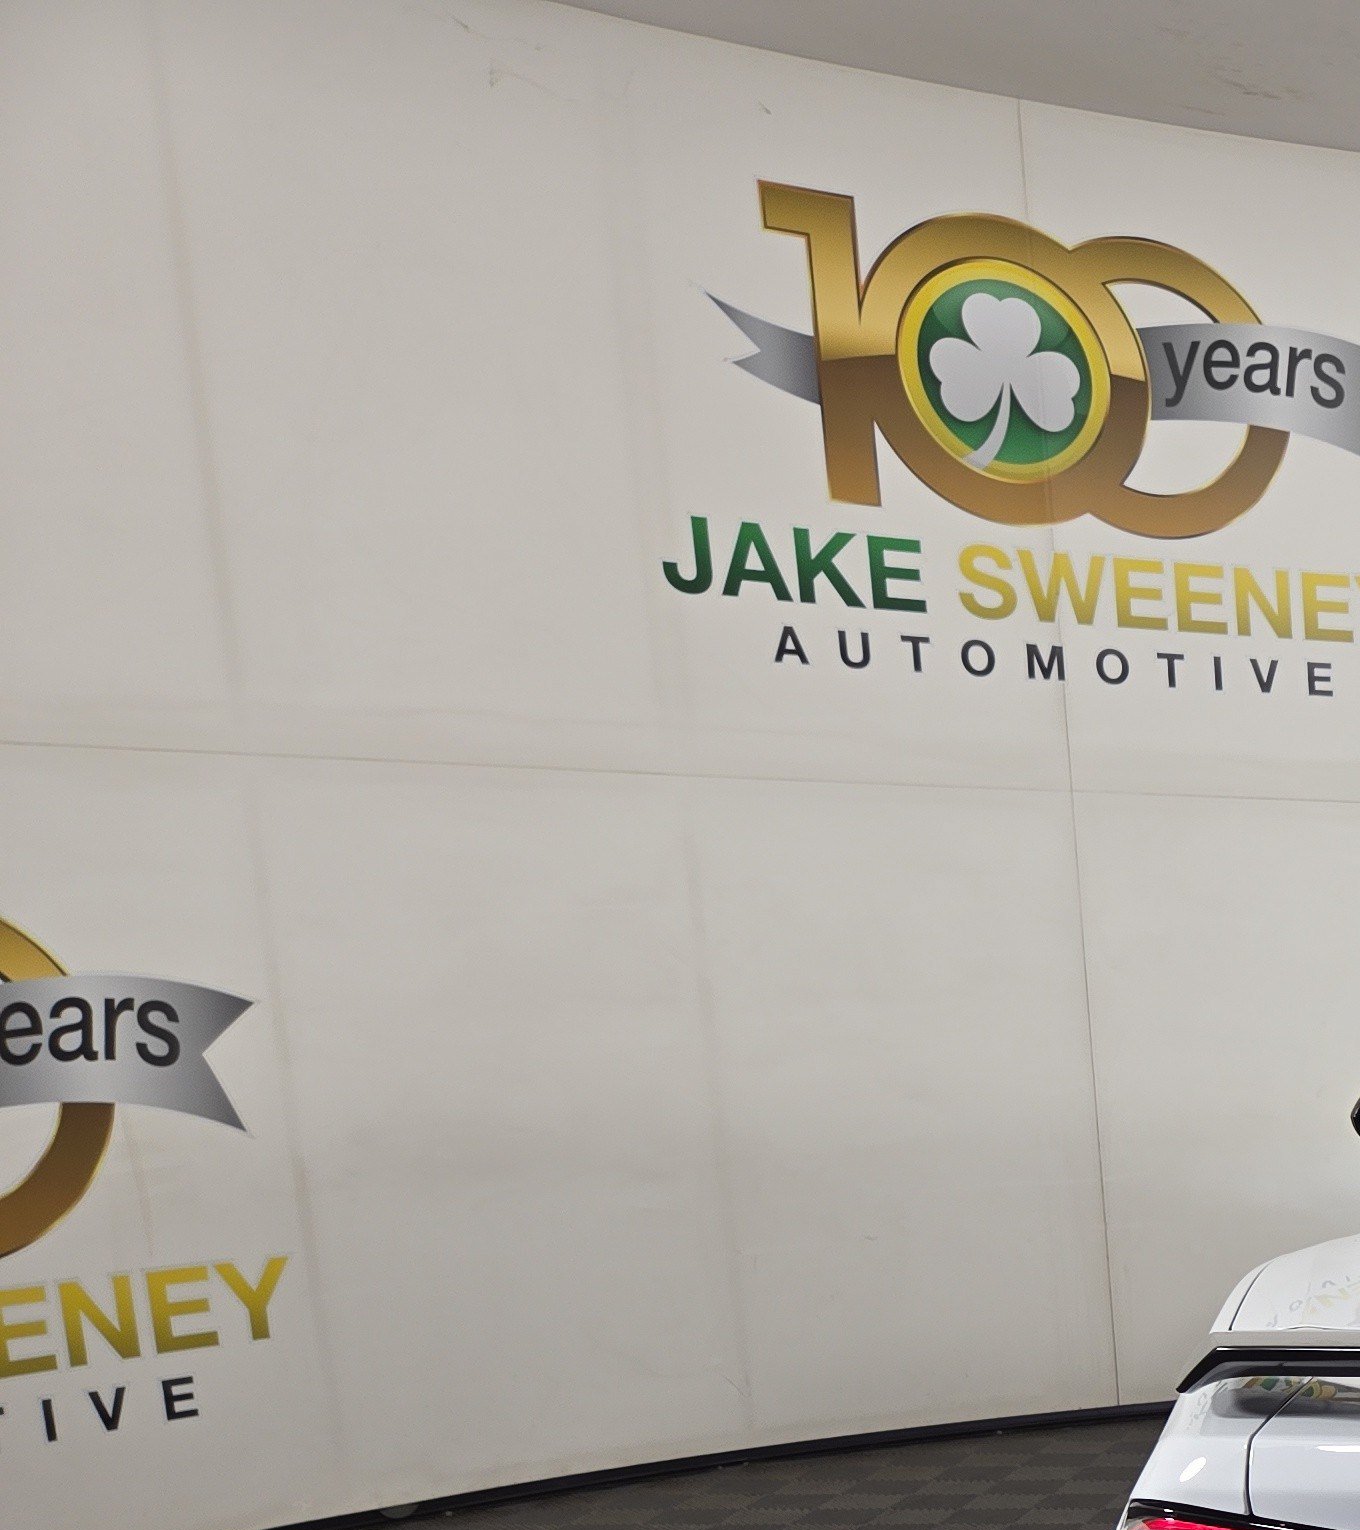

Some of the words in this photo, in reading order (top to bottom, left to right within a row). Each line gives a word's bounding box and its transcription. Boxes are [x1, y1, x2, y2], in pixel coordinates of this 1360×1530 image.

[1162, 337, 1348, 409] years
[661, 515, 929, 613] JAKE
[774, 625, 1335, 697] AUTOMOTIVE
[0, 1376, 199, 1442] IVE
